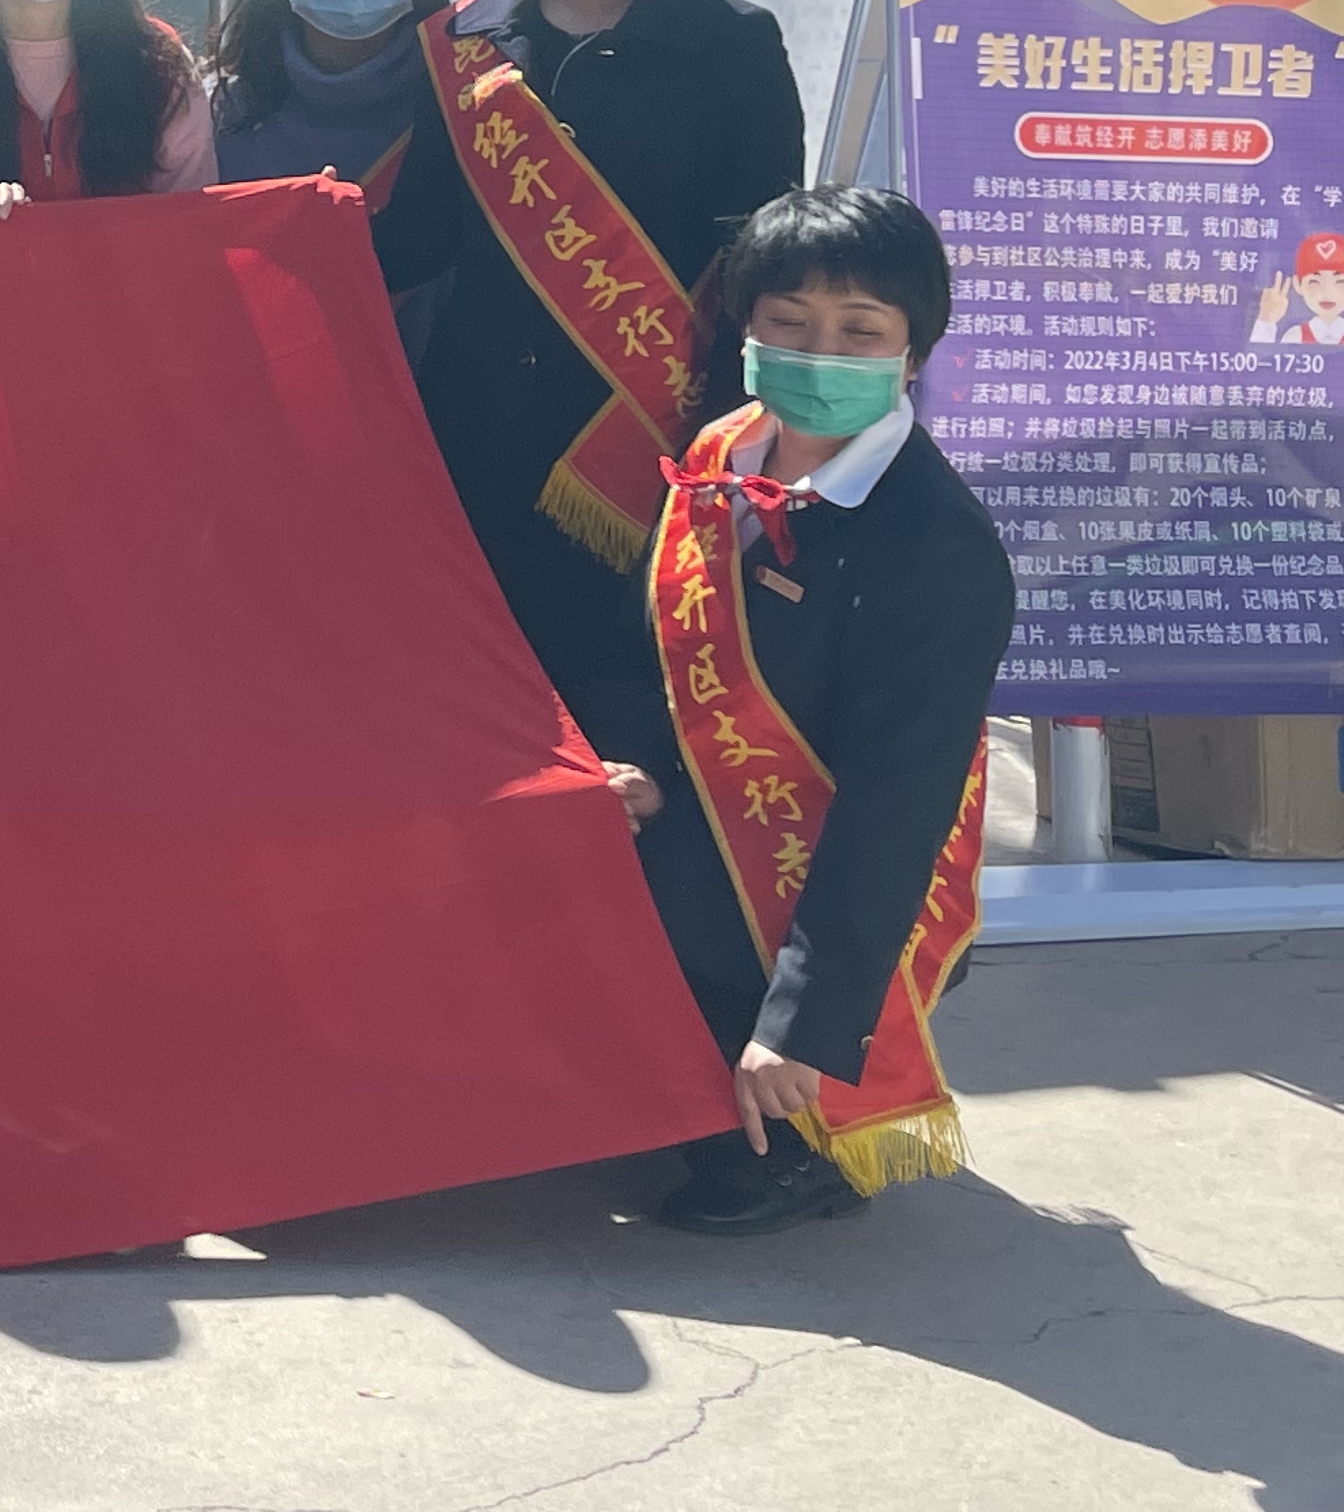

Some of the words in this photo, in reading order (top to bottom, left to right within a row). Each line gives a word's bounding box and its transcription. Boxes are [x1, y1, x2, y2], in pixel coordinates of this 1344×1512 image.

[933, 24, 1344, 98] “美好生活捍卫者
[1144, 126, 1253, 154] 志愿添美好
[941, 451, 1266, 475] 行统一垃圾分类处理，即可获得宣传品；
